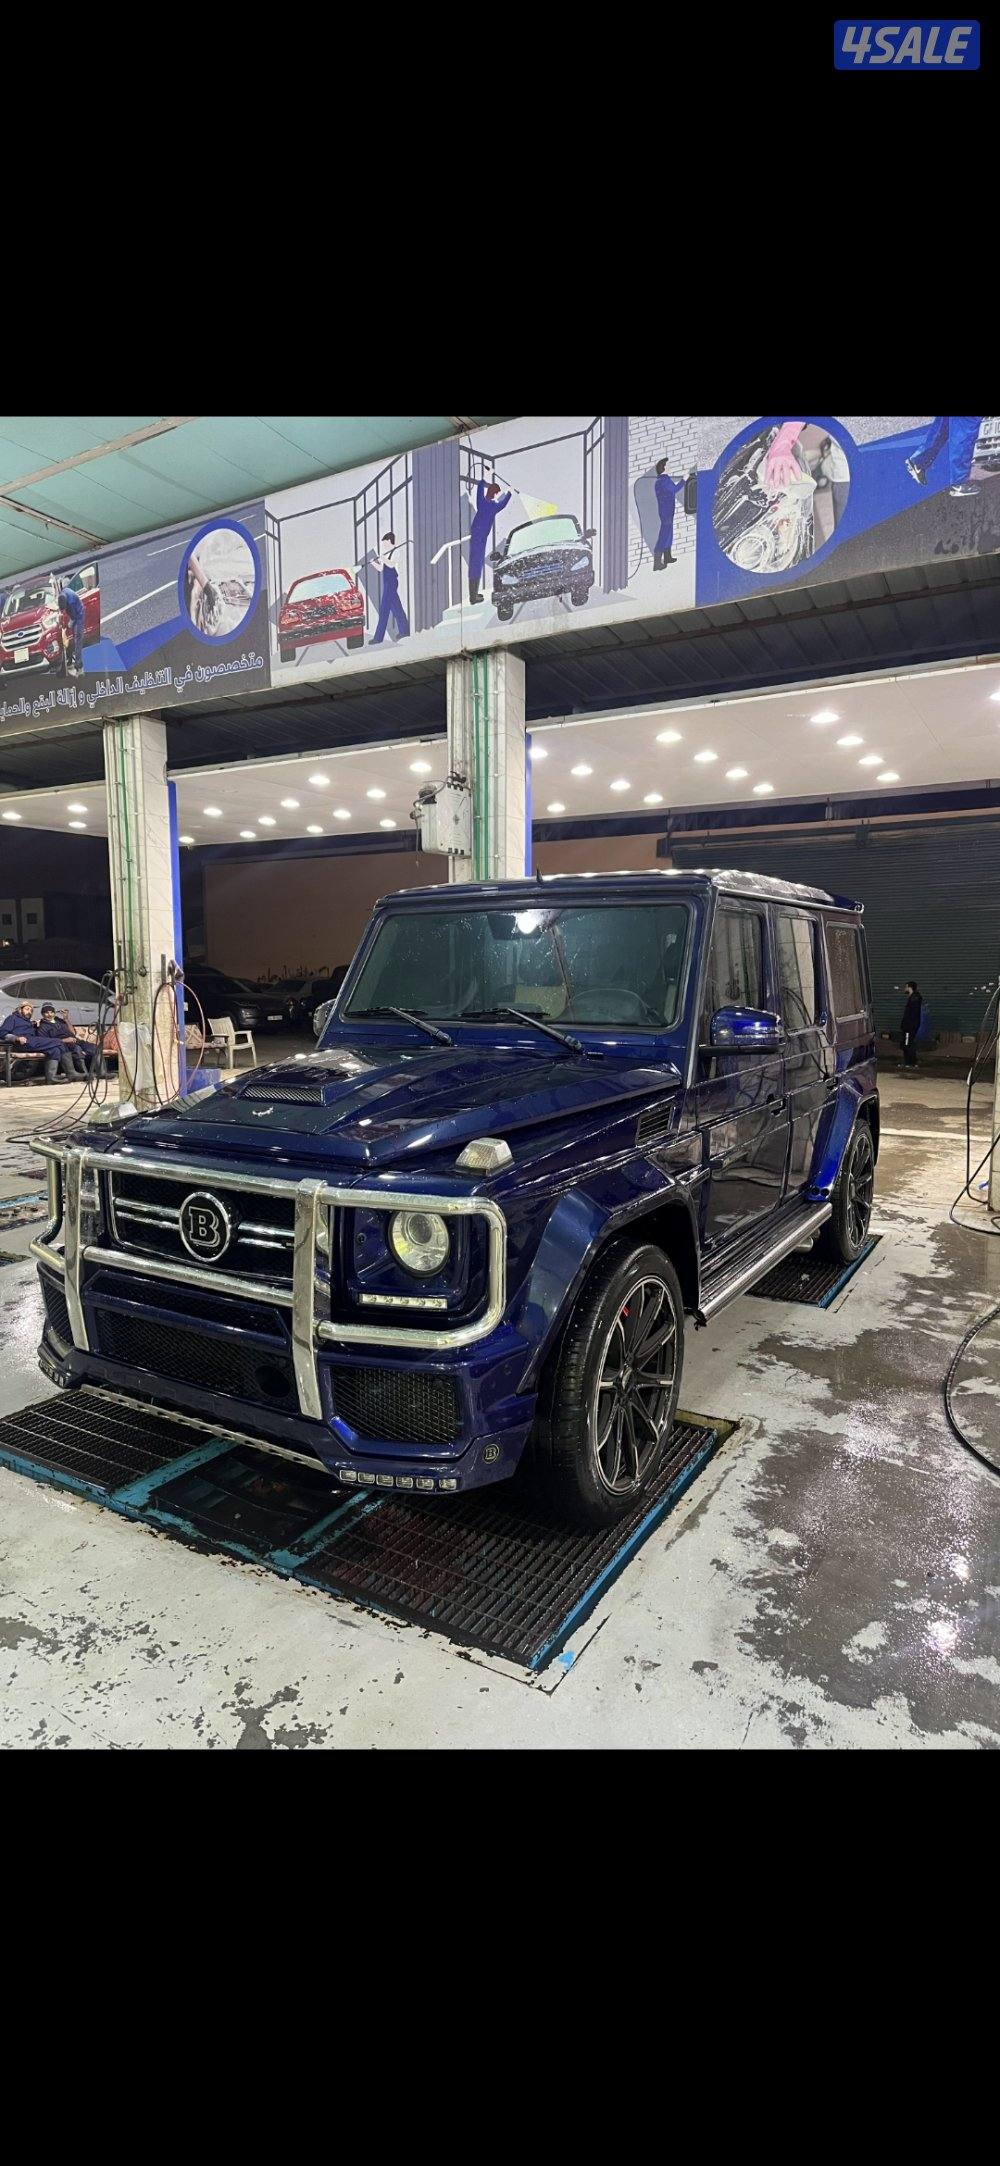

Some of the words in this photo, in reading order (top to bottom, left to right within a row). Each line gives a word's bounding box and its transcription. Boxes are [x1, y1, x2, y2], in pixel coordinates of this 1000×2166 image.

[174, 665, 193, 693] في
[195, 652, 264, 682] متخصصون
[87, 676, 123, 708] الداخلي
[125, 667, 172, 695] التنظيف
[0, 697, 31, 722] والحماي
[32, 691, 56, 718] البقع
[57, 687, 77, 708] إزالة
[78, 690, 85, 705] و
[188, 1206, 220, 1248] B
[485, 1447, 497, 1460] B
